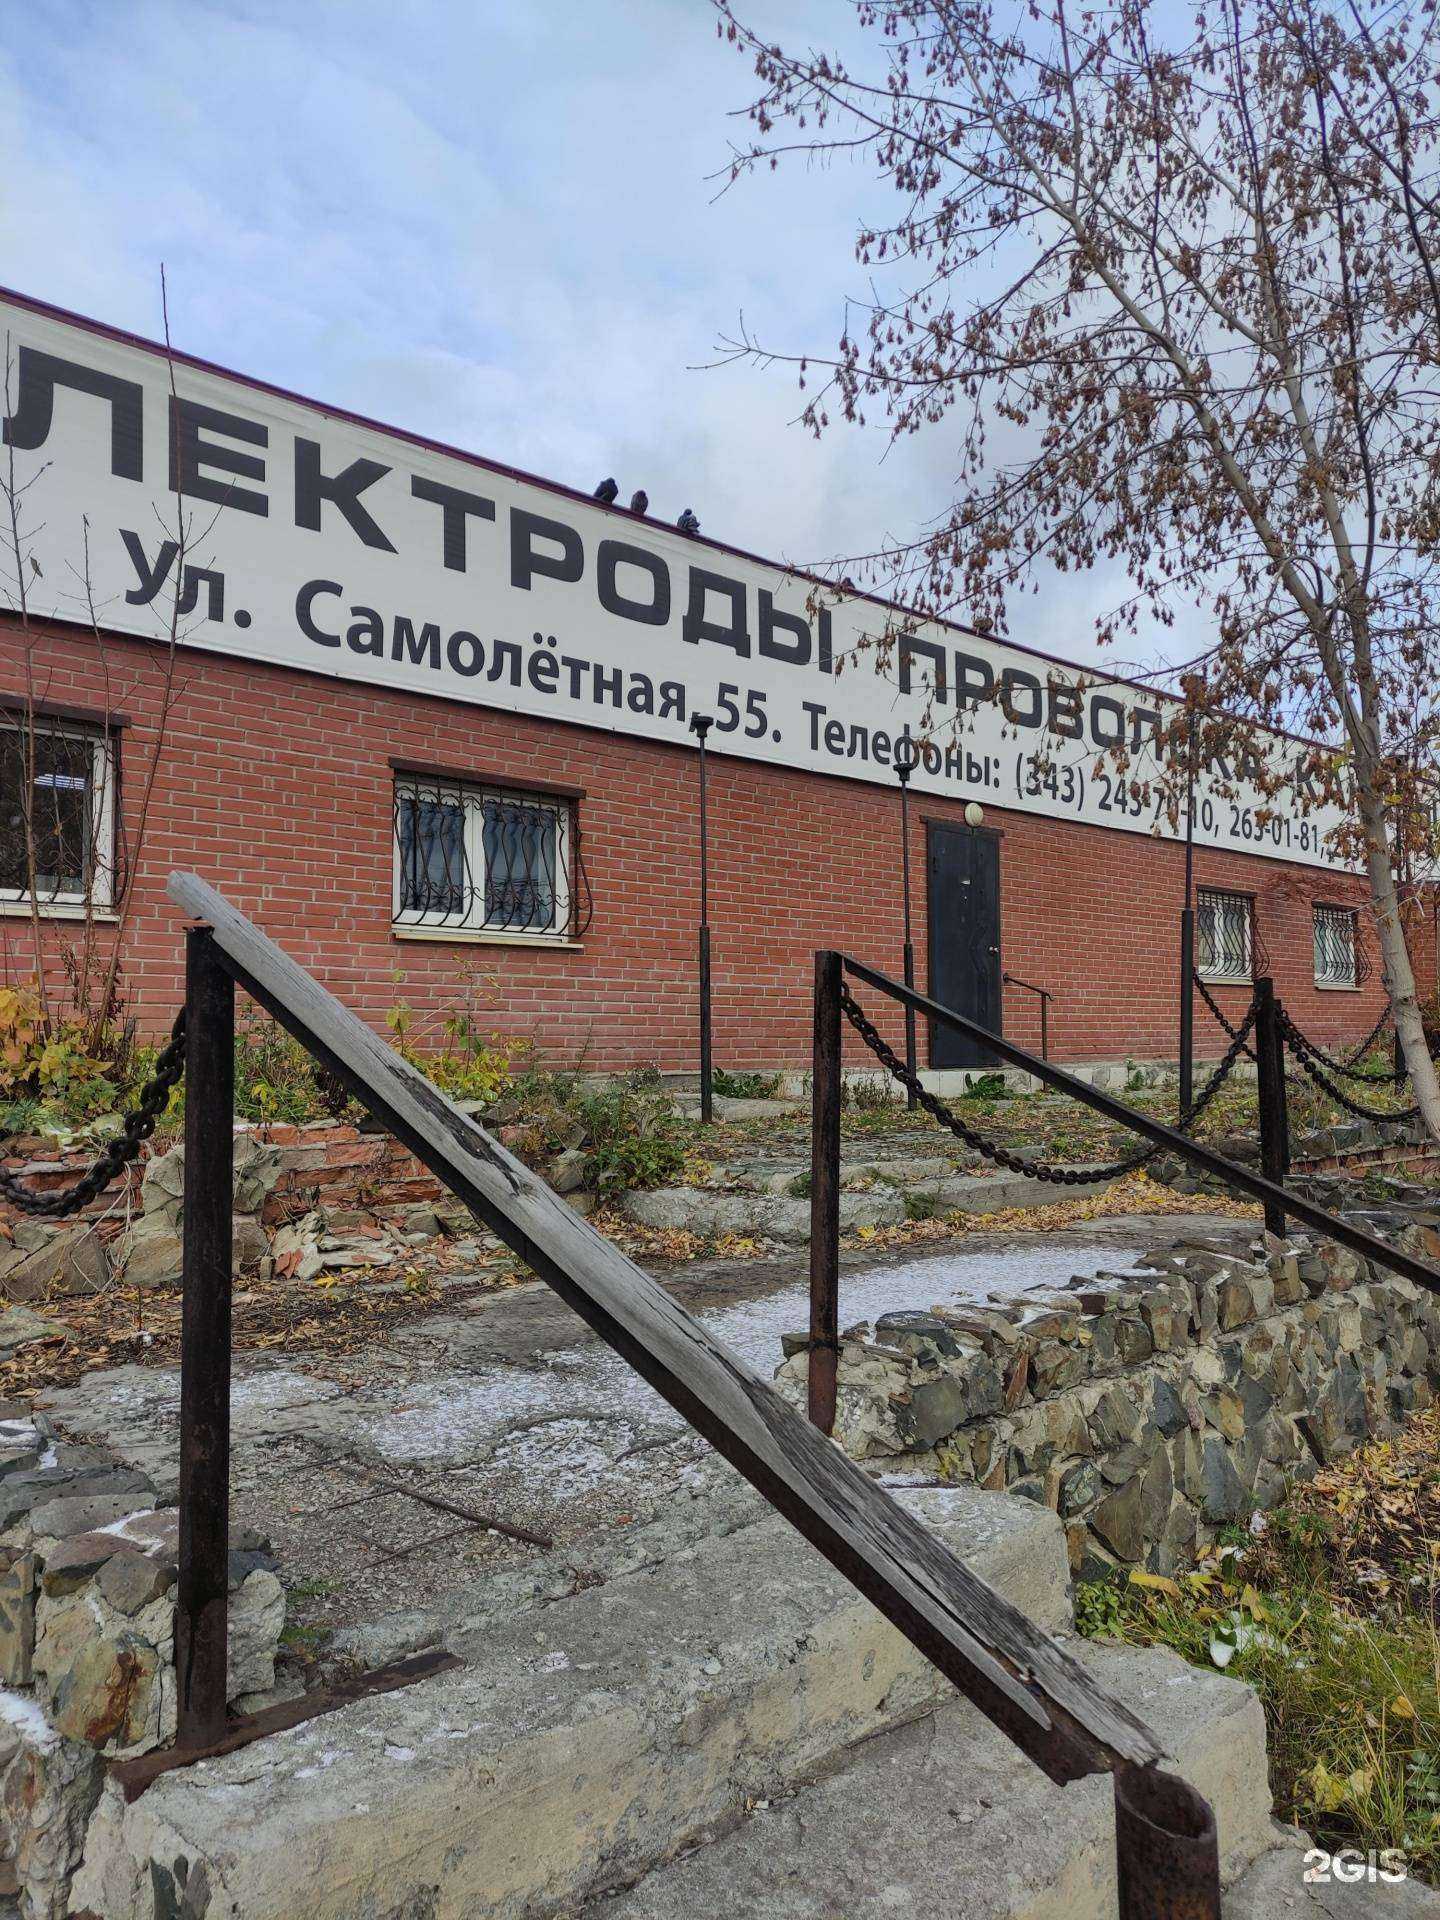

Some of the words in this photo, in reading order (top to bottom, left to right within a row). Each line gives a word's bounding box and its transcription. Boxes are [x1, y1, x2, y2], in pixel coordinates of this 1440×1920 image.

[3, 345, 832, 674] ЛЕКТРОДЫ
[898, 633, 1262, 786] ПРОВОЛКА
[118, 528, 252, 628] ул.
[715, 682, 782, 743] 55.
[802, 701, 1000, 789] Телефоны:
[1016, 752, 1084, 811] (343)
